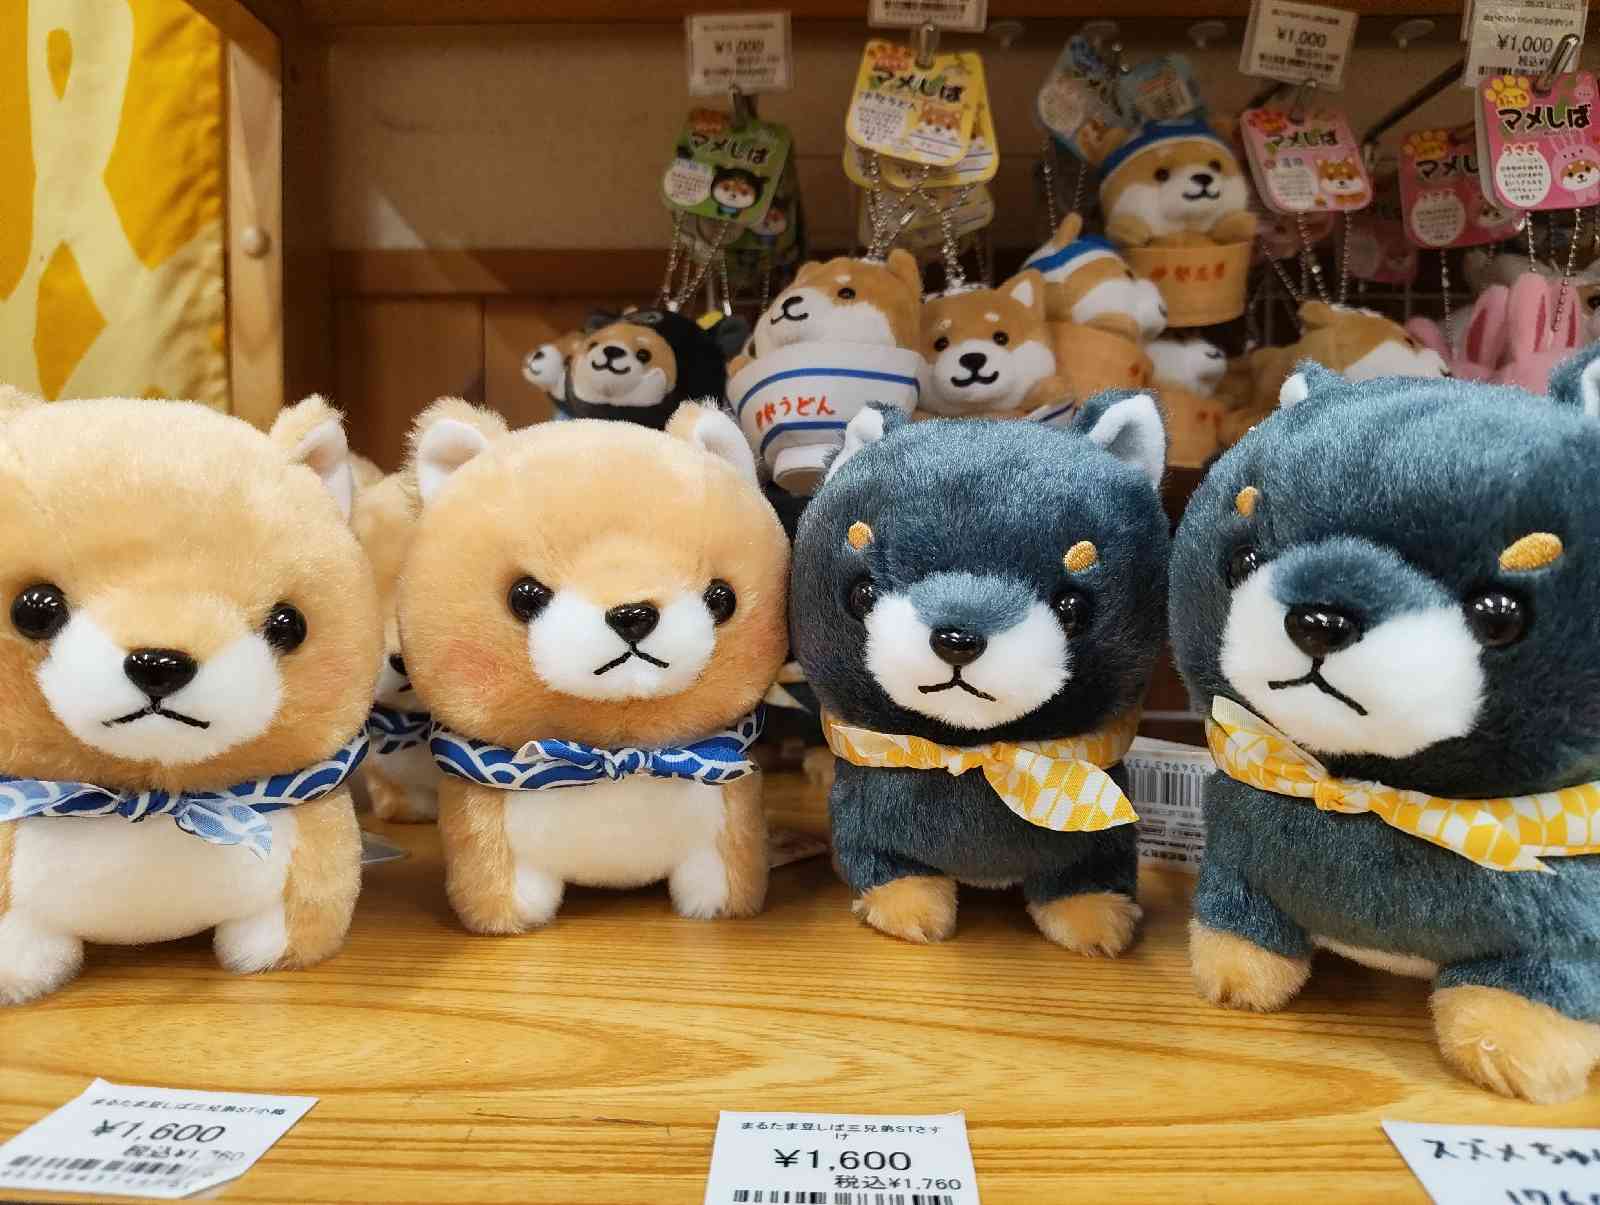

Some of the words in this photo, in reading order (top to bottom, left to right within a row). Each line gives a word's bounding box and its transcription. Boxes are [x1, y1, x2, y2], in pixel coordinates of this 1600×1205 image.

[1496, 33, 1553, 53] ¥1,000
[871, 66, 964, 102] マメしば
[1496, 103, 1592, 130] マメしば
[690, 131, 768, 164] マメしば
[1270, 129, 1338, 147] マメしば
[1415, 154, 1479, 179] マメし
[92, 1120, 227, 1143] ¥1,600
[123, 1144, 245, 1162] 税込¥1,760
[773, 1148, 913, 1172] ¥1,600
[833, 1175, 963, 1191] 税込¥1,760
